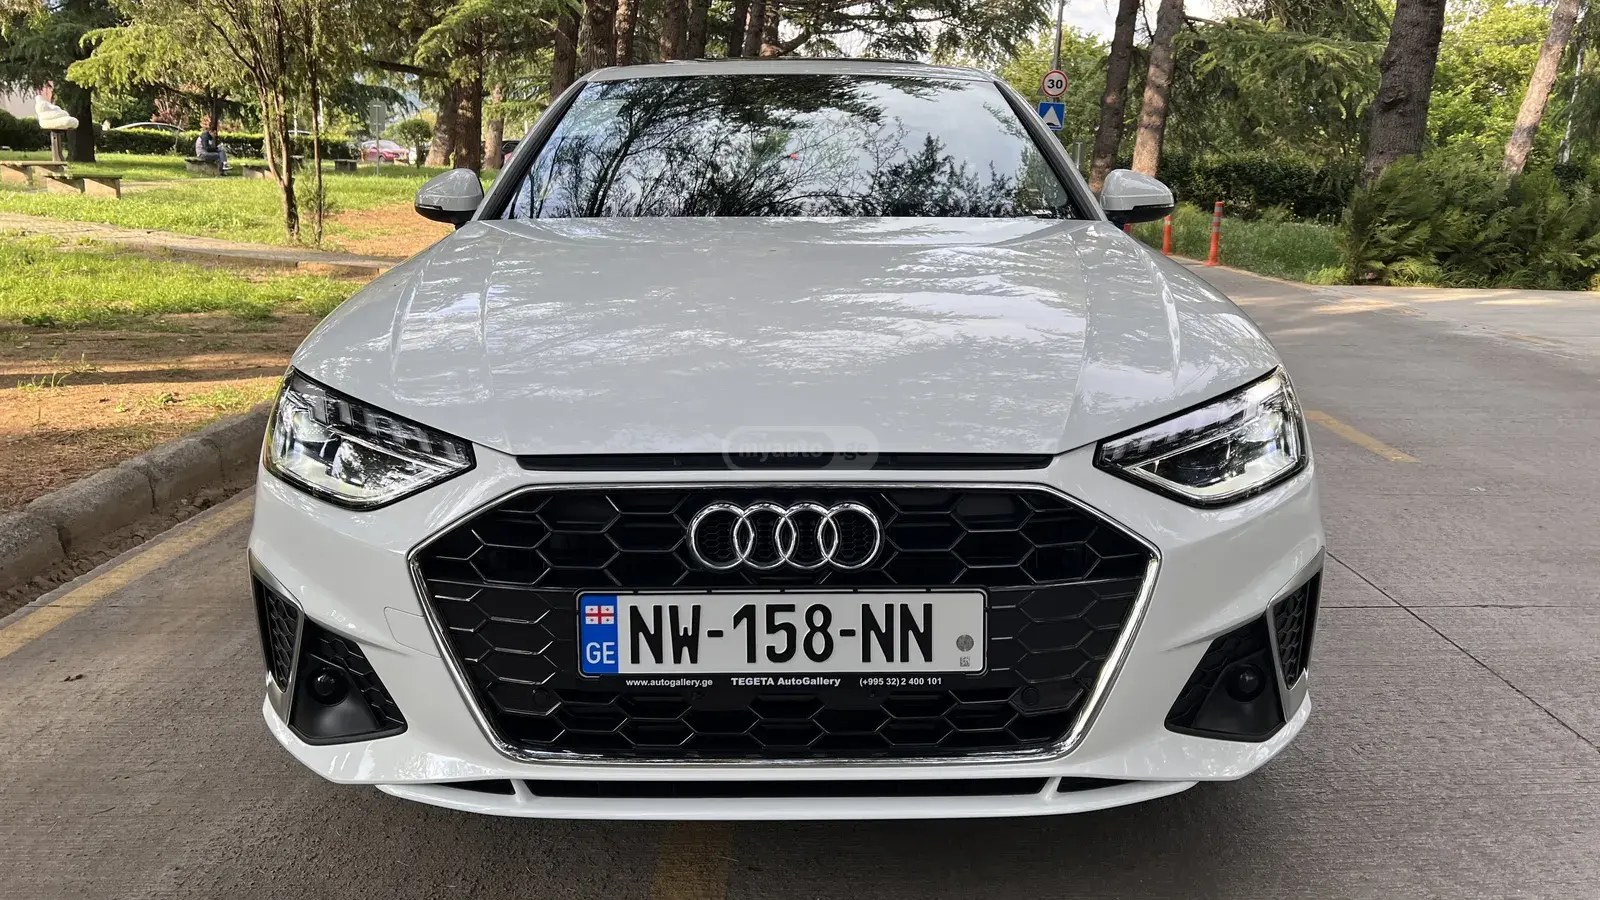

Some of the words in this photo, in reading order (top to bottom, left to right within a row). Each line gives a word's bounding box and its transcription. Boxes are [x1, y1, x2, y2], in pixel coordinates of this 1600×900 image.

[1047, 79, 1063, 89] 30
[629, 603, 933, 664] NW-158-NN
[586, 642, 615, 664] GE
[626, 677, 713, 688] www.autogallery.ge
[731, 677, 774, 686] TEGETA
[777, 677, 841, 688] AutoGallery
[859, 677, 884, 687] (+995
[908, 677, 924, 686] 400
[926, 677, 942, 686] 101
